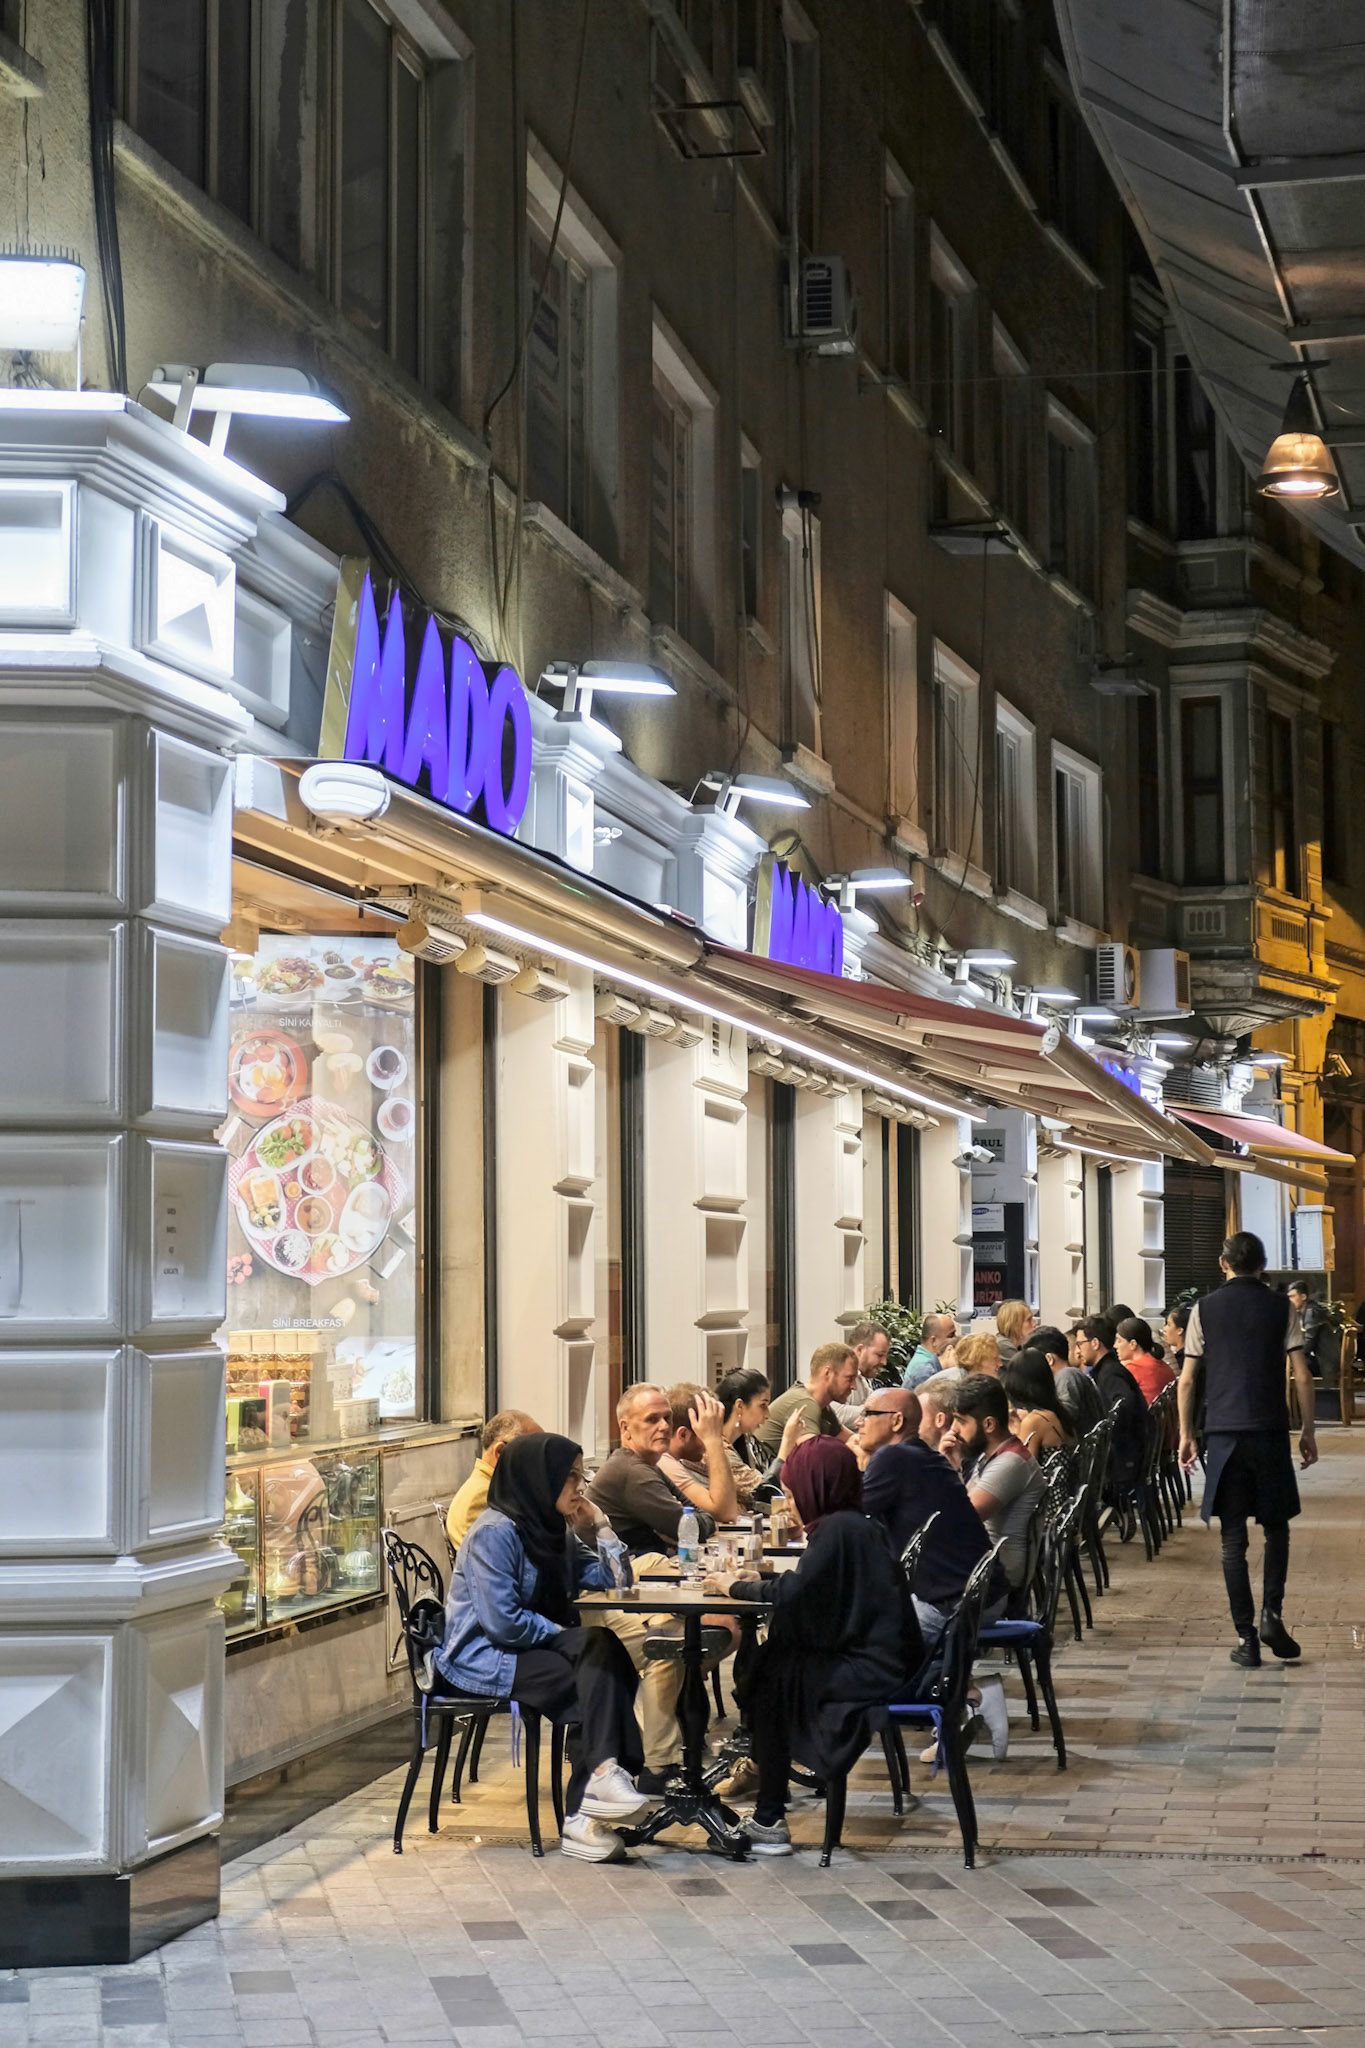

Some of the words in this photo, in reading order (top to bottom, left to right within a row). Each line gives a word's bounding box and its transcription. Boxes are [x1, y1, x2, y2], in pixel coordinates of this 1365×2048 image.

[344, 571, 533, 837] MADO
[279, 1017, 297, 1027] SİNİ
[272, 1317, 291, 1328] SİNİ
[293, 1319, 346, 1328] BREAKFAST
